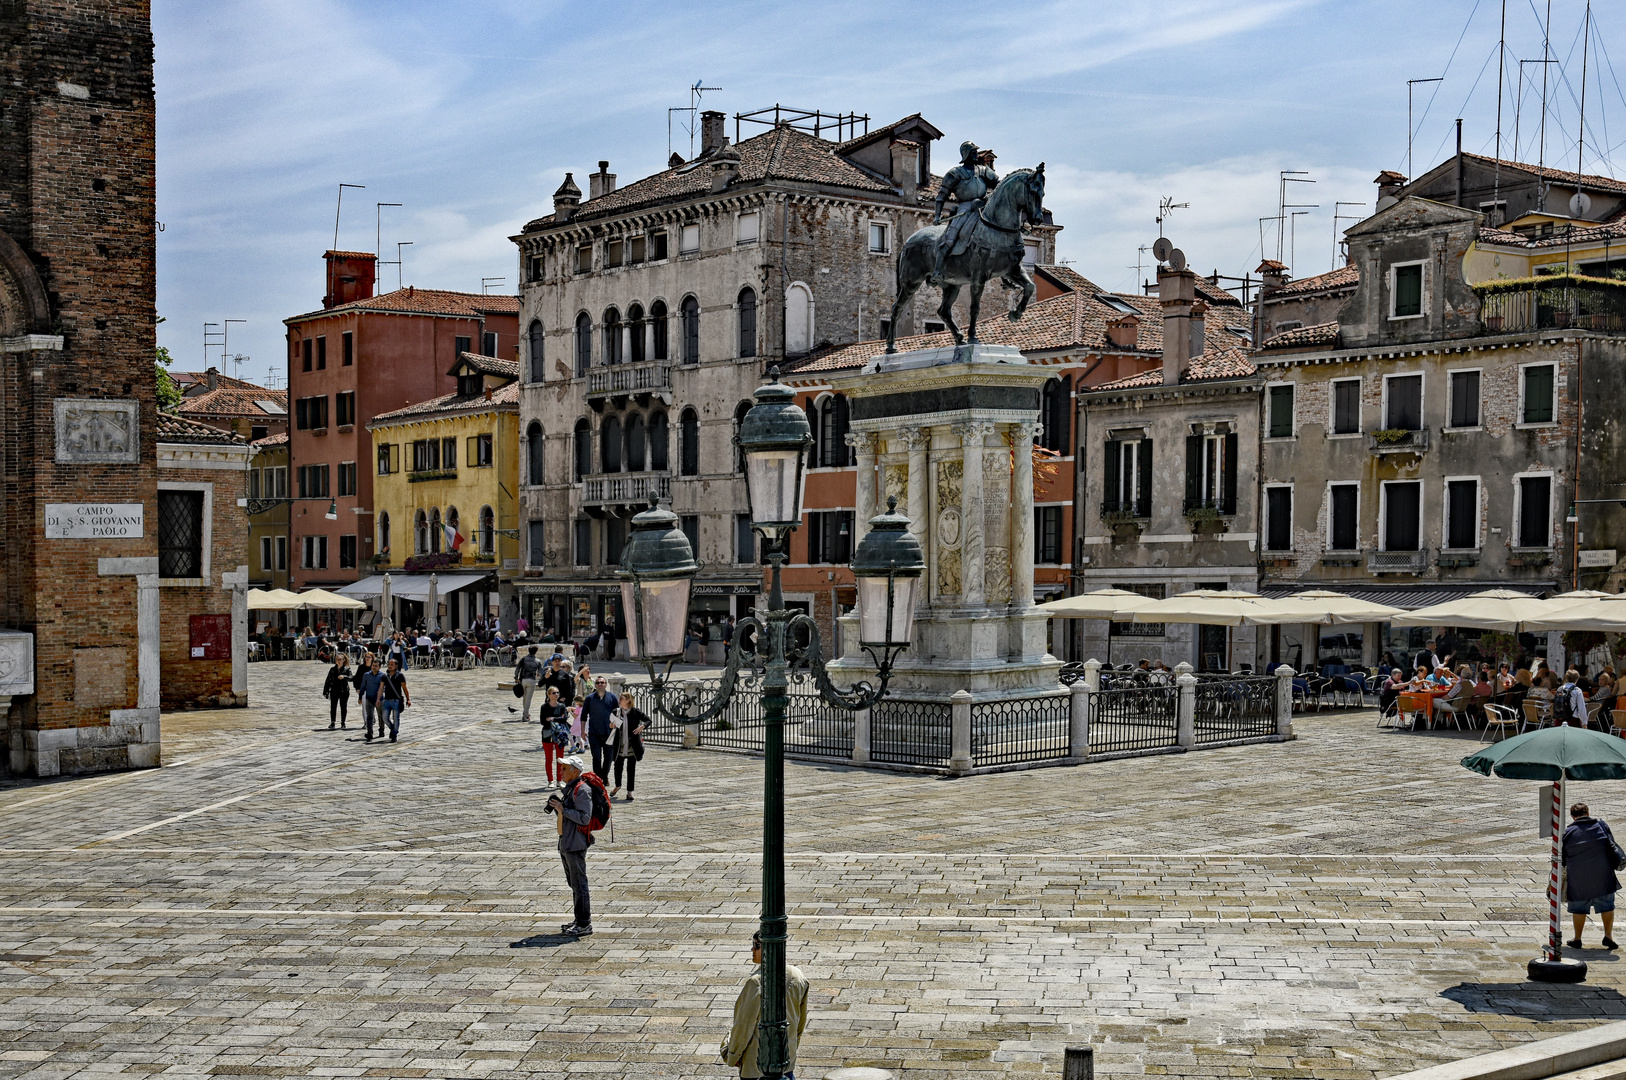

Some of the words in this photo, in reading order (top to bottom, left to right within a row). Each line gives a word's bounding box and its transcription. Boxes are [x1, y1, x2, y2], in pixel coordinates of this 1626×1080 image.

[77, 507, 113, 515] CAMPO
[91, 517, 141, 525] GIOVANNI
[92, 527, 127, 536] PAOLO
